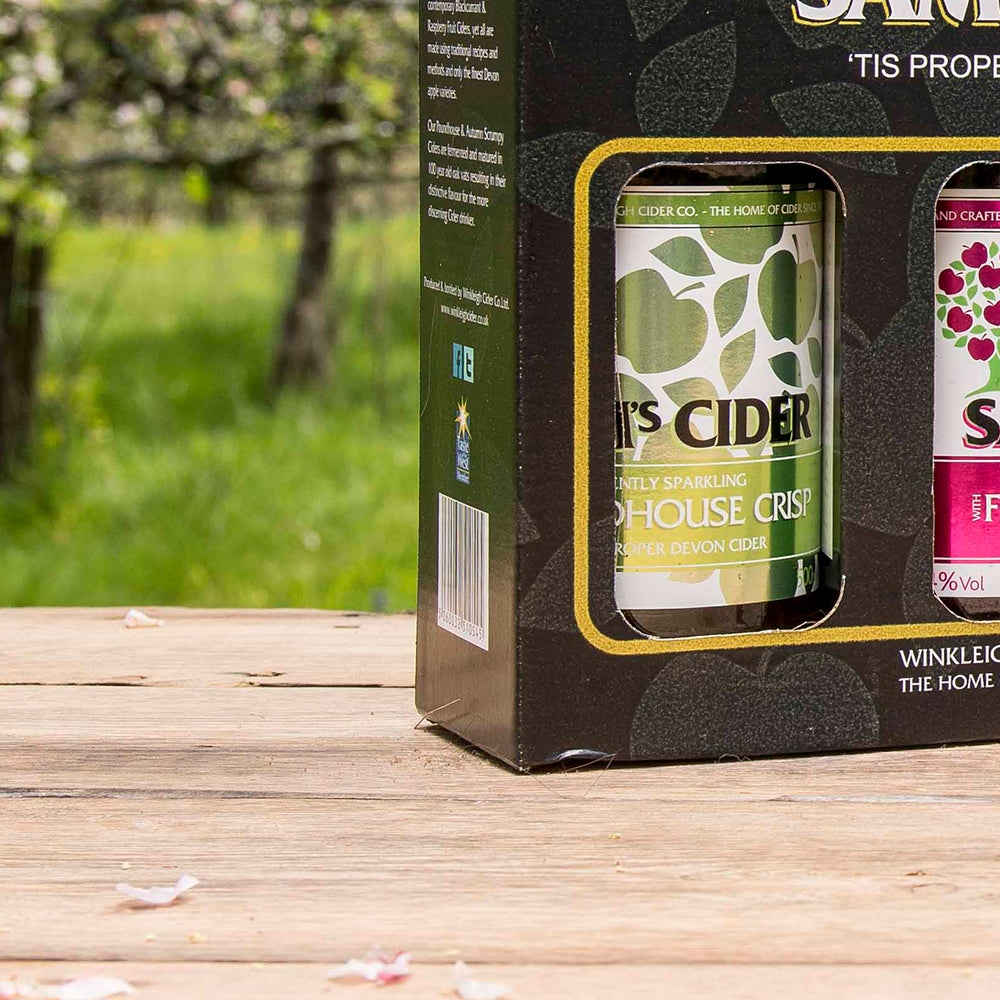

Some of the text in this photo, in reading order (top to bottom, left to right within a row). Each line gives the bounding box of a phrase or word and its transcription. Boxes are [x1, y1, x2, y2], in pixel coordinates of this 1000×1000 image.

[638, 206, 675, 217] CIDER
[677, 206, 698, 217] CO.
[709, 206, 731, 216] THE
[733, 205, 766, 216] HOME
[768, 204, 780, 215] OF
[672, 392, 811, 449] CIDER
[663, 473, 746, 490] SPARKLING
[754, 488, 811, 525] CRISP
[972, 494, 981, 521] WITH
[670, 540, 725, 555] DEVON
[729, 536, 767, 552] CIDER
[898, 676, 932, 693] THE
[938, 673, 994, 691] HOME
